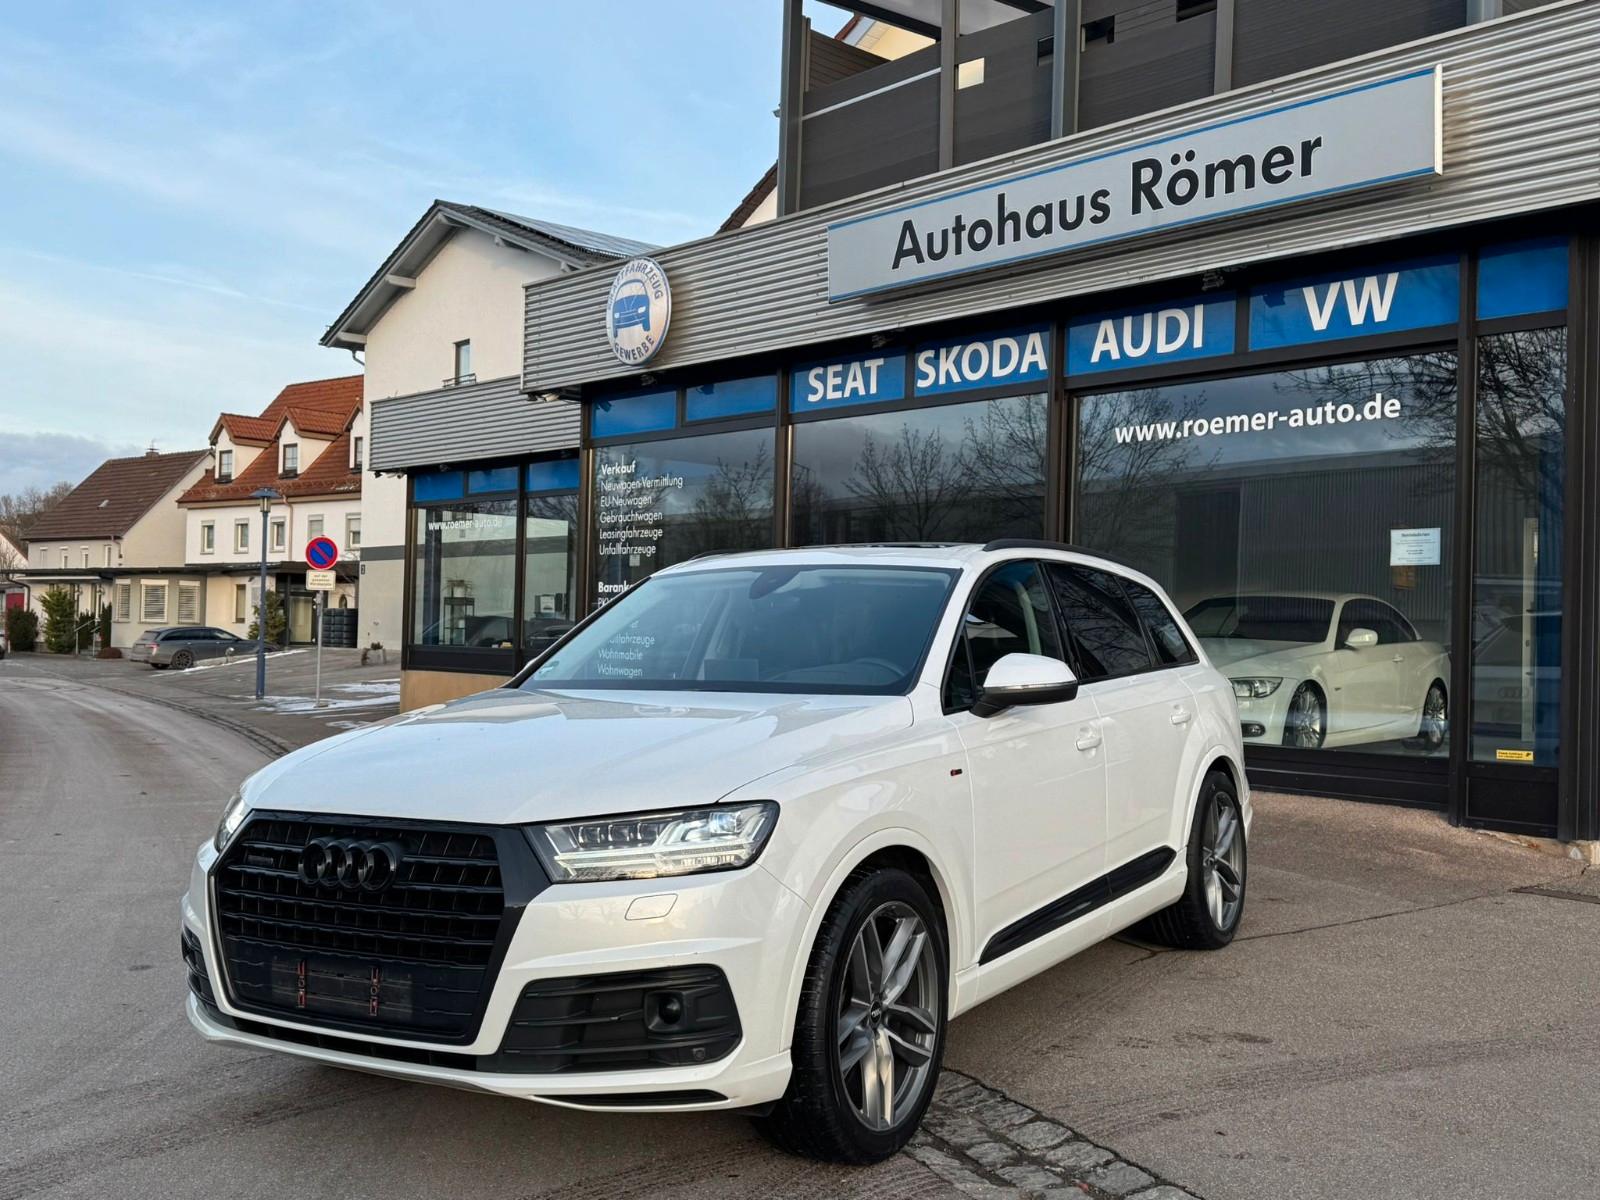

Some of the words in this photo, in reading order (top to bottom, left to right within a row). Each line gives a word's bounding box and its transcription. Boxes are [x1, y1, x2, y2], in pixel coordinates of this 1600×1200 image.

[892, 189, 1111, 270] Autohaus
[1131, 136, 1322, 215] Römer
[1302, 272, 1399, 331] VW
[1090, 304, 1204, 363] AUDI
[614, 335, 655, 361] GEWERBE
[916, 332, 1048, 388] SKODA
[807, 357, 884, 402] SEAT
[1114, 392, 1401, 444] www.roemer-auto.de
[601, 459, 636, 475] Verkauf
[600, 474, 683, 493] Neuwagen-Vermittlung
[600, 495, 652, 508] EU-Neuwagen
[600, 509, 663, 524] Gebrauchtwagen
[599, 525, 663, 541] Leasingfahrzeuge
[599, 542, 656, 557] Unfallfahrzeuge
[599, 648, 643, 660] Wohnmobile
[597, 664, 643, 678] Wohnwagen
